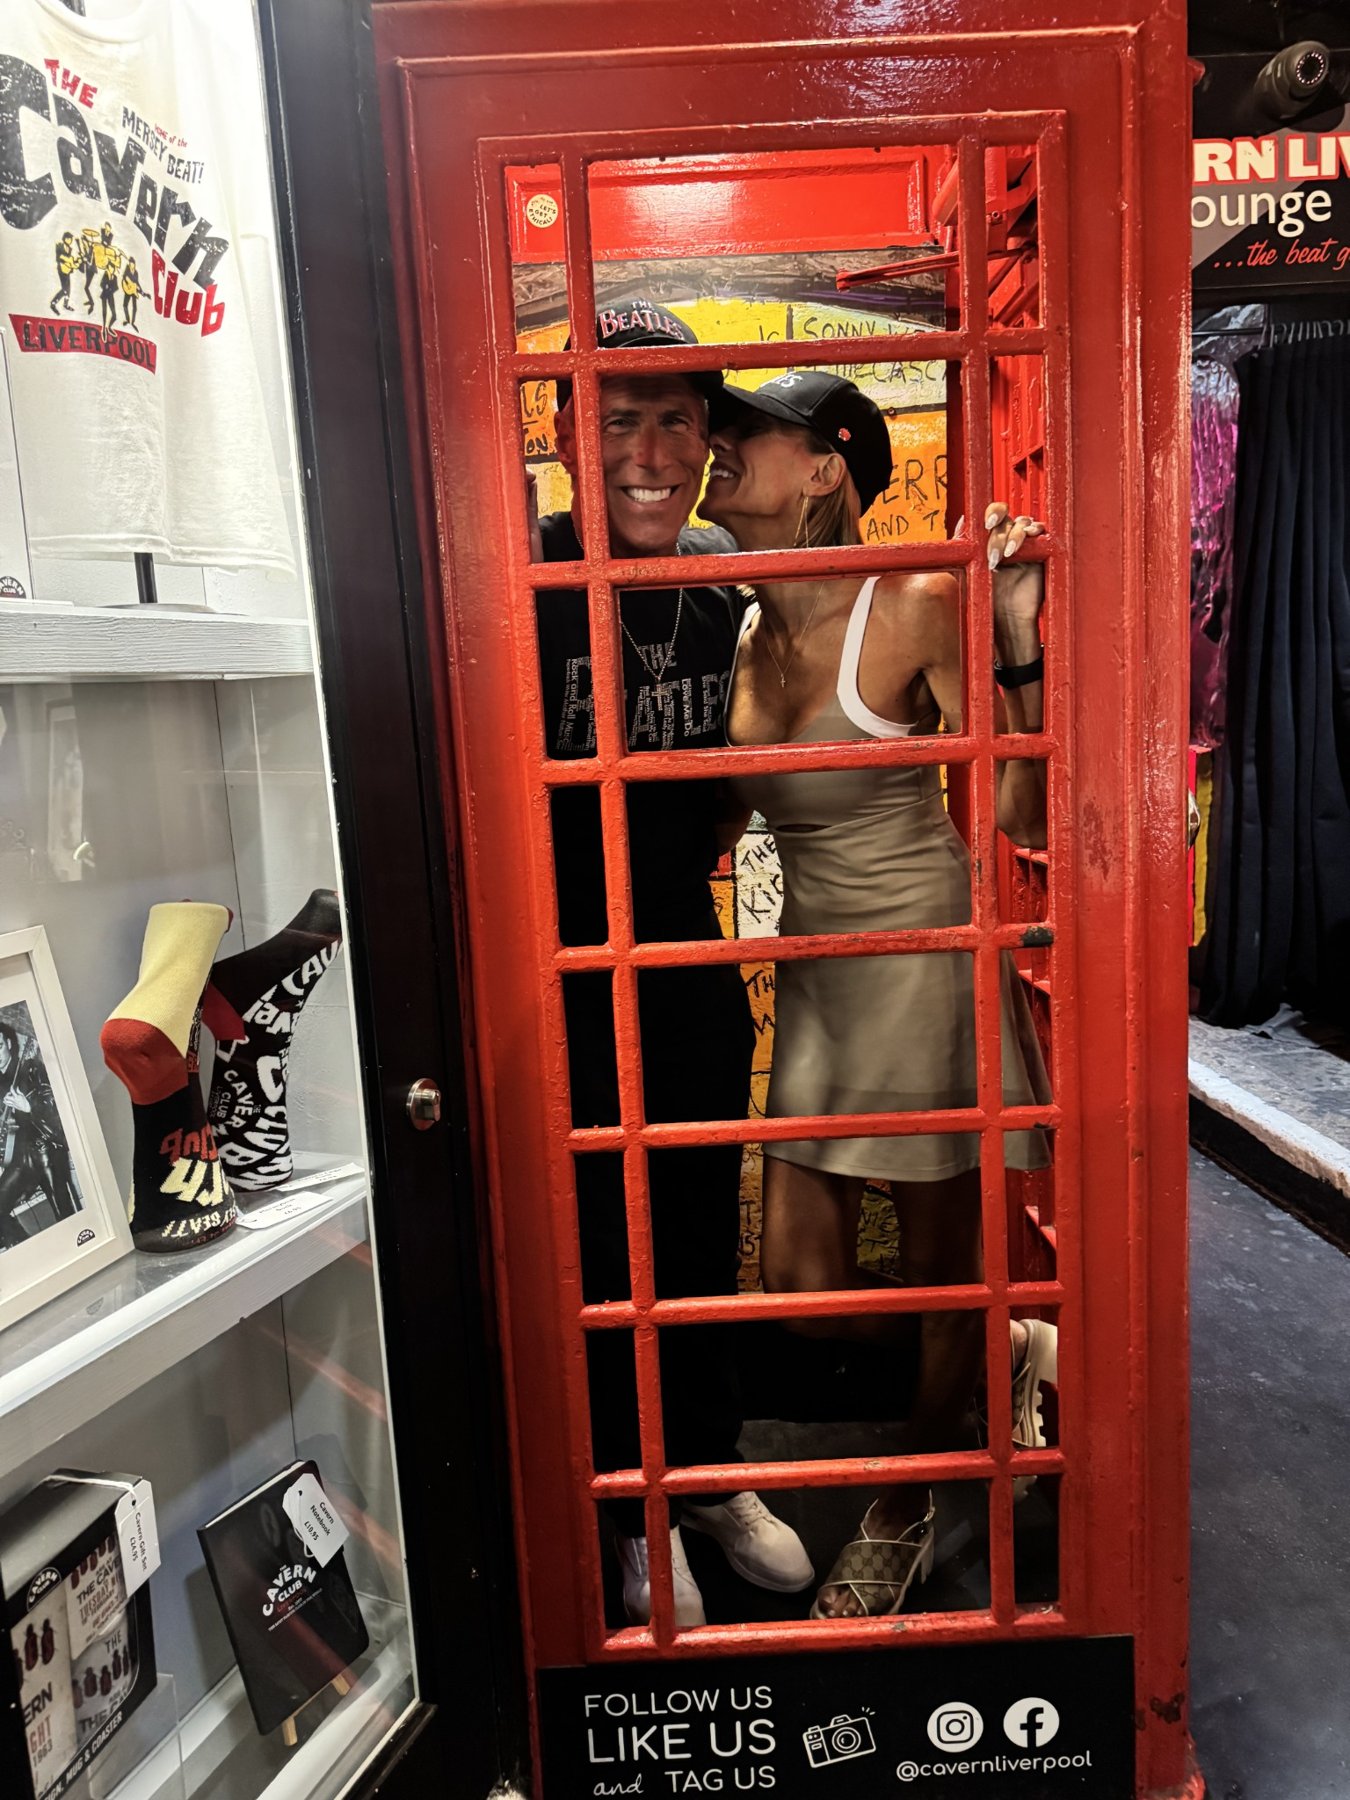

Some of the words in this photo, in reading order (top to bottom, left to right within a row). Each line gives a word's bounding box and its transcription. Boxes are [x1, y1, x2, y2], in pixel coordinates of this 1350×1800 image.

[44, 58, 98, 109] THE
[122, 106, 168, 161] MERSEY
[167, 153, 205, 184] BEAT!
[535, 209, 547, 218] GET
[1285, 238, 1338, 265] beat
[598, 308, 687, 342] BEATLES
[23, 321, 157, 370] LIVERPOOL
[866, 513, 909, 541] AND
[569, 683, 578, 702] and
[681, 678, 690, 701] Love
[567, 703, 577, 720] Roll
[682, 705, 690, 720] Me
[683, 722, 691, 737] Do
[741, 836, 776, 872] THE
[217, 1091, 231, 1119] CLUB
[135, 1512, 143, 1541] Cavern
[310, 1504, 331, 1536] Notebook
[319, 1501, 335, 1524] Cavern
[304, 1520, 319, 1541] £10.95
[29, 1571, 58, 1604] CAVERN
[76, 1580, 96, 1605] THE
[262, 1564, 317, 1617] CAVERN
[278, 1579, 303, 1603] CLUB
[105, 1631, 122, 1653] THE
[584, 1688, 720, 1718] FOLLOW
[730, 1685, 773, 1710] US
[79, 1706, 108, 1734] THE
[66, 1757, 83, 1784] MUG
[91, 1711, 123, 1751] COASTER
[587, 1724, 692, 1763] LIKE
[709, 1718, 776, 1757] US
[896, 1750, 1093, 1782] @cavernliverpool
[593, 1773, 644, 1796] and
[664, 1768, 723, 1793] TAG
[734, 1765, 776, 1789] US
